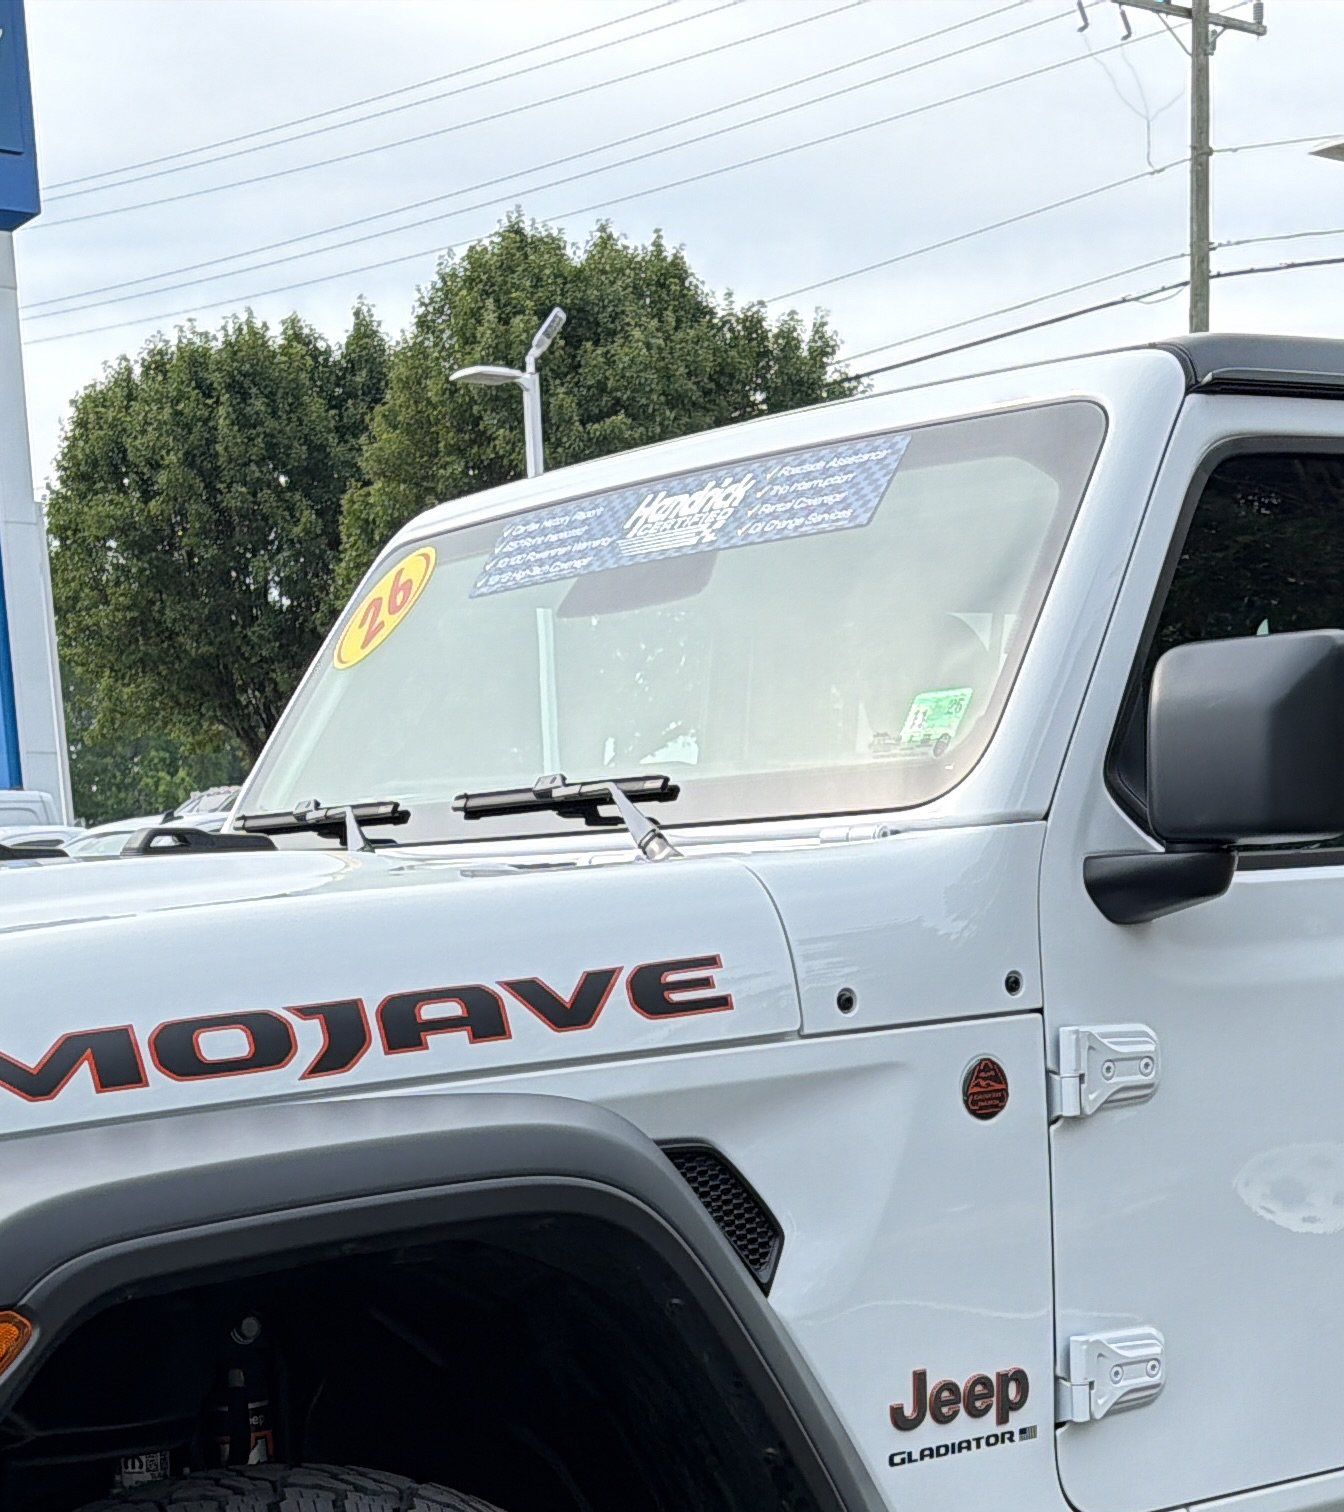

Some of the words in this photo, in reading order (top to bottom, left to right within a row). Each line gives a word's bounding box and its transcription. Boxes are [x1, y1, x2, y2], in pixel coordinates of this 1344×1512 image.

[623, 472, 756, 539] Hendrick
[636, 507, 735, 537] CERTIFIED
[358, 567, 413, 650] 26
[889, 1366, 1030, 1432] Jeep
[888, 1430, 1015, 1468] GLADIATOR
